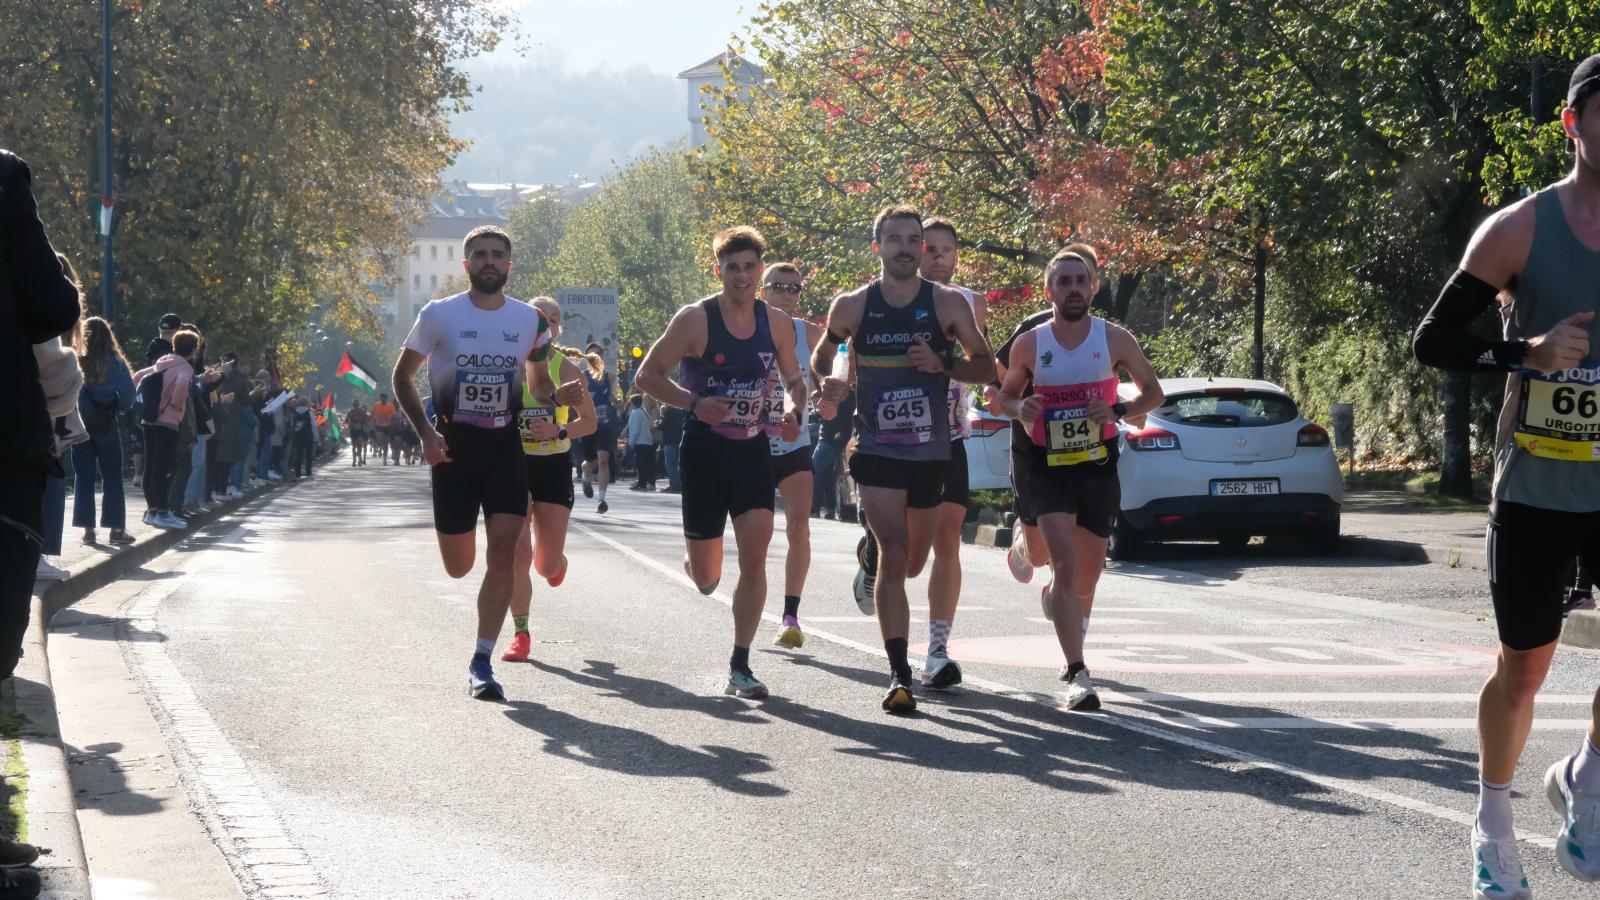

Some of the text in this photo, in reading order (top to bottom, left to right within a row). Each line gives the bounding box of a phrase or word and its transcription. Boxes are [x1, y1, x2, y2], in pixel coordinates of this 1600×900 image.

[567, 294, 615, 305] ERRENTERIA
[464, 385, 502, 403] 951
[1552, 386, 1598, 419] 66
[473, 404, 496, 412] XANTI
[727, 400, 760, 417] 796
[882, 400, 925, 420] 645
[896, 420, 916, 428] UNAI
[1062, 420, 1090, 439] 84
[1220, 482, 1273, 494] 2562 HHT
